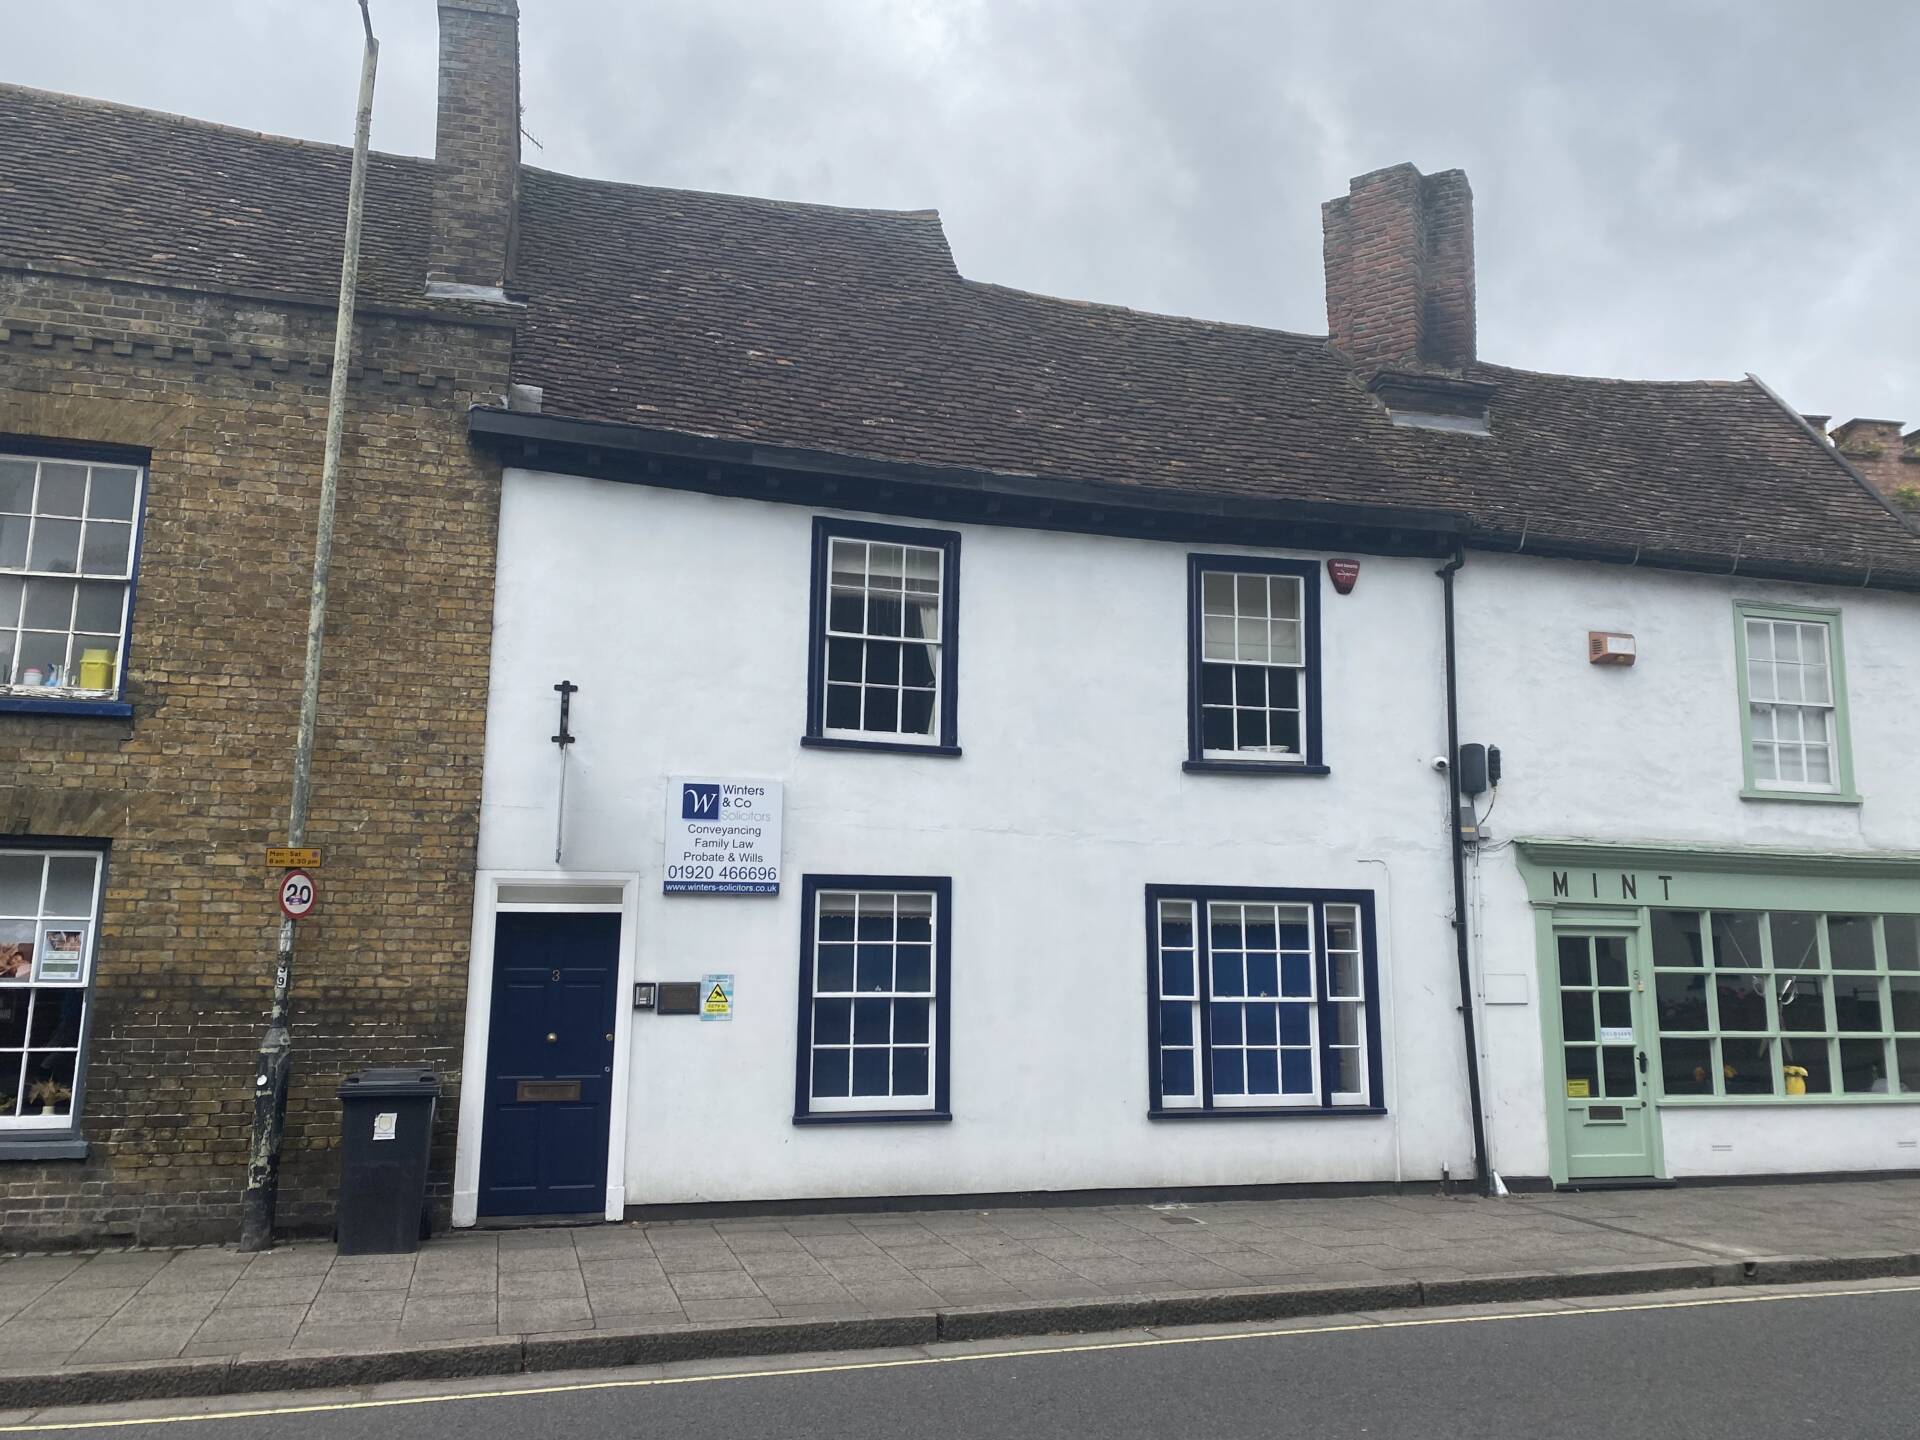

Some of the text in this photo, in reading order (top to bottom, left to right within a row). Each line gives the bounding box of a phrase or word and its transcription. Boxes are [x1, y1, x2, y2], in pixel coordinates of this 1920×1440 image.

[723, 784, 765, 796] Winters
[722, 797, 752, 808] & Co
[722, 810, 771, 822] Solicitors
[687, 824, 761, 837] Conveyancing
[695, 838, 754, 850] Family Law
[683, 851, 764, 862] Probate & Wills
[668, 865, 777, 880] 01920 466696
[665, 883, 777, 893] www.winters-solicitors.co.uk
[1552, 871, 1673, 901] MINT
[285, 883, 312, 905] 20
[551, 969, 561, 982] 3
